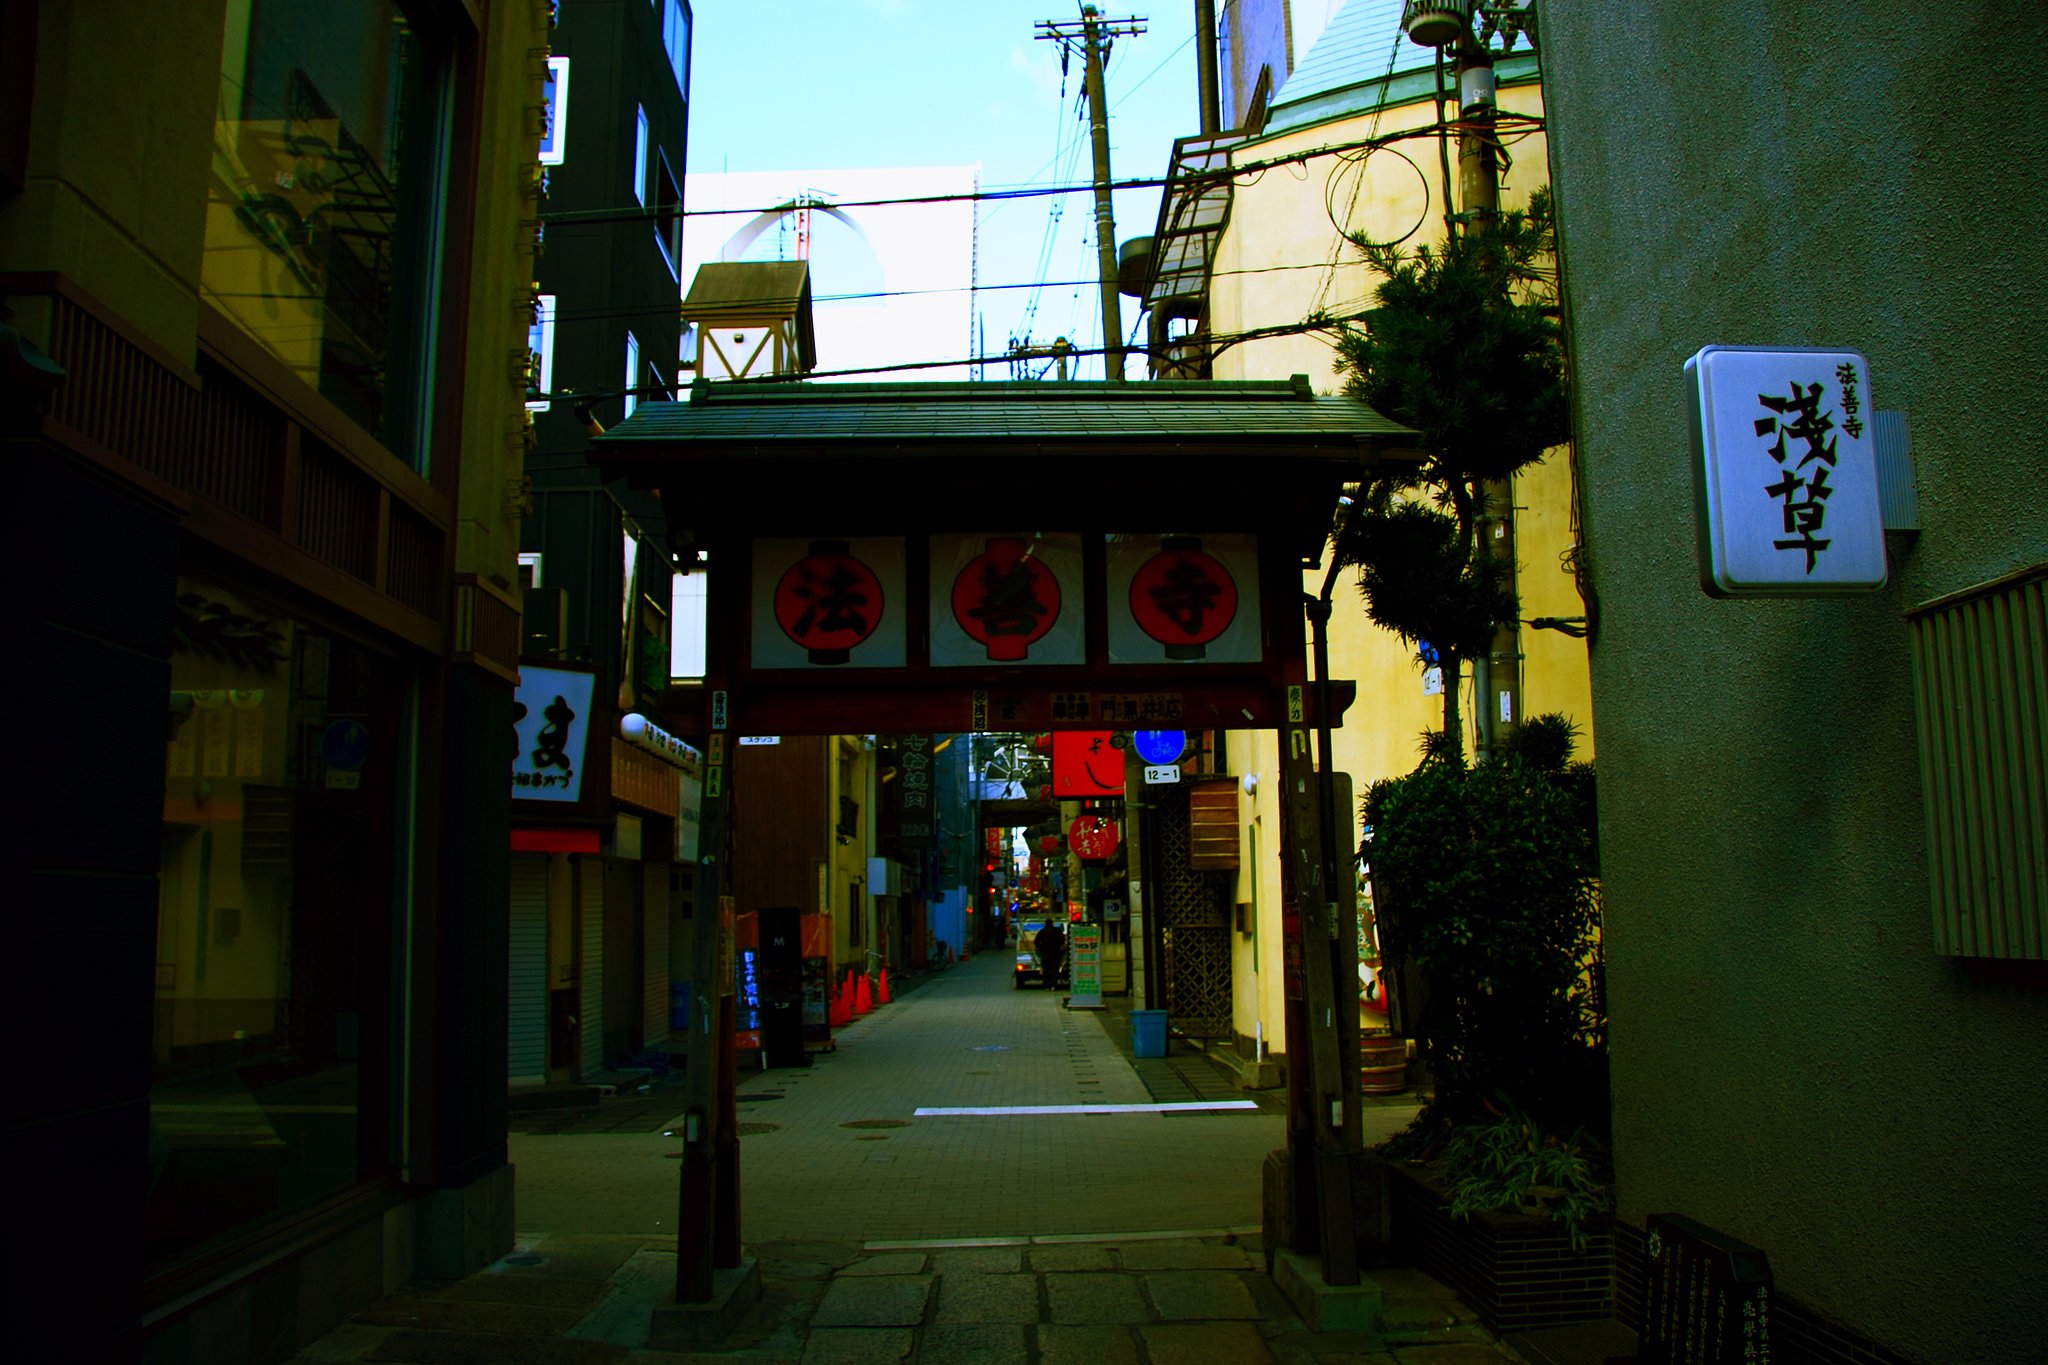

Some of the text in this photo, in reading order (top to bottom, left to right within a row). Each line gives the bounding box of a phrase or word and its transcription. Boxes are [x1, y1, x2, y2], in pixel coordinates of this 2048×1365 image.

[1835, 362, 1864, 440] 法善寺
[512, 695, 575, 770] ま
